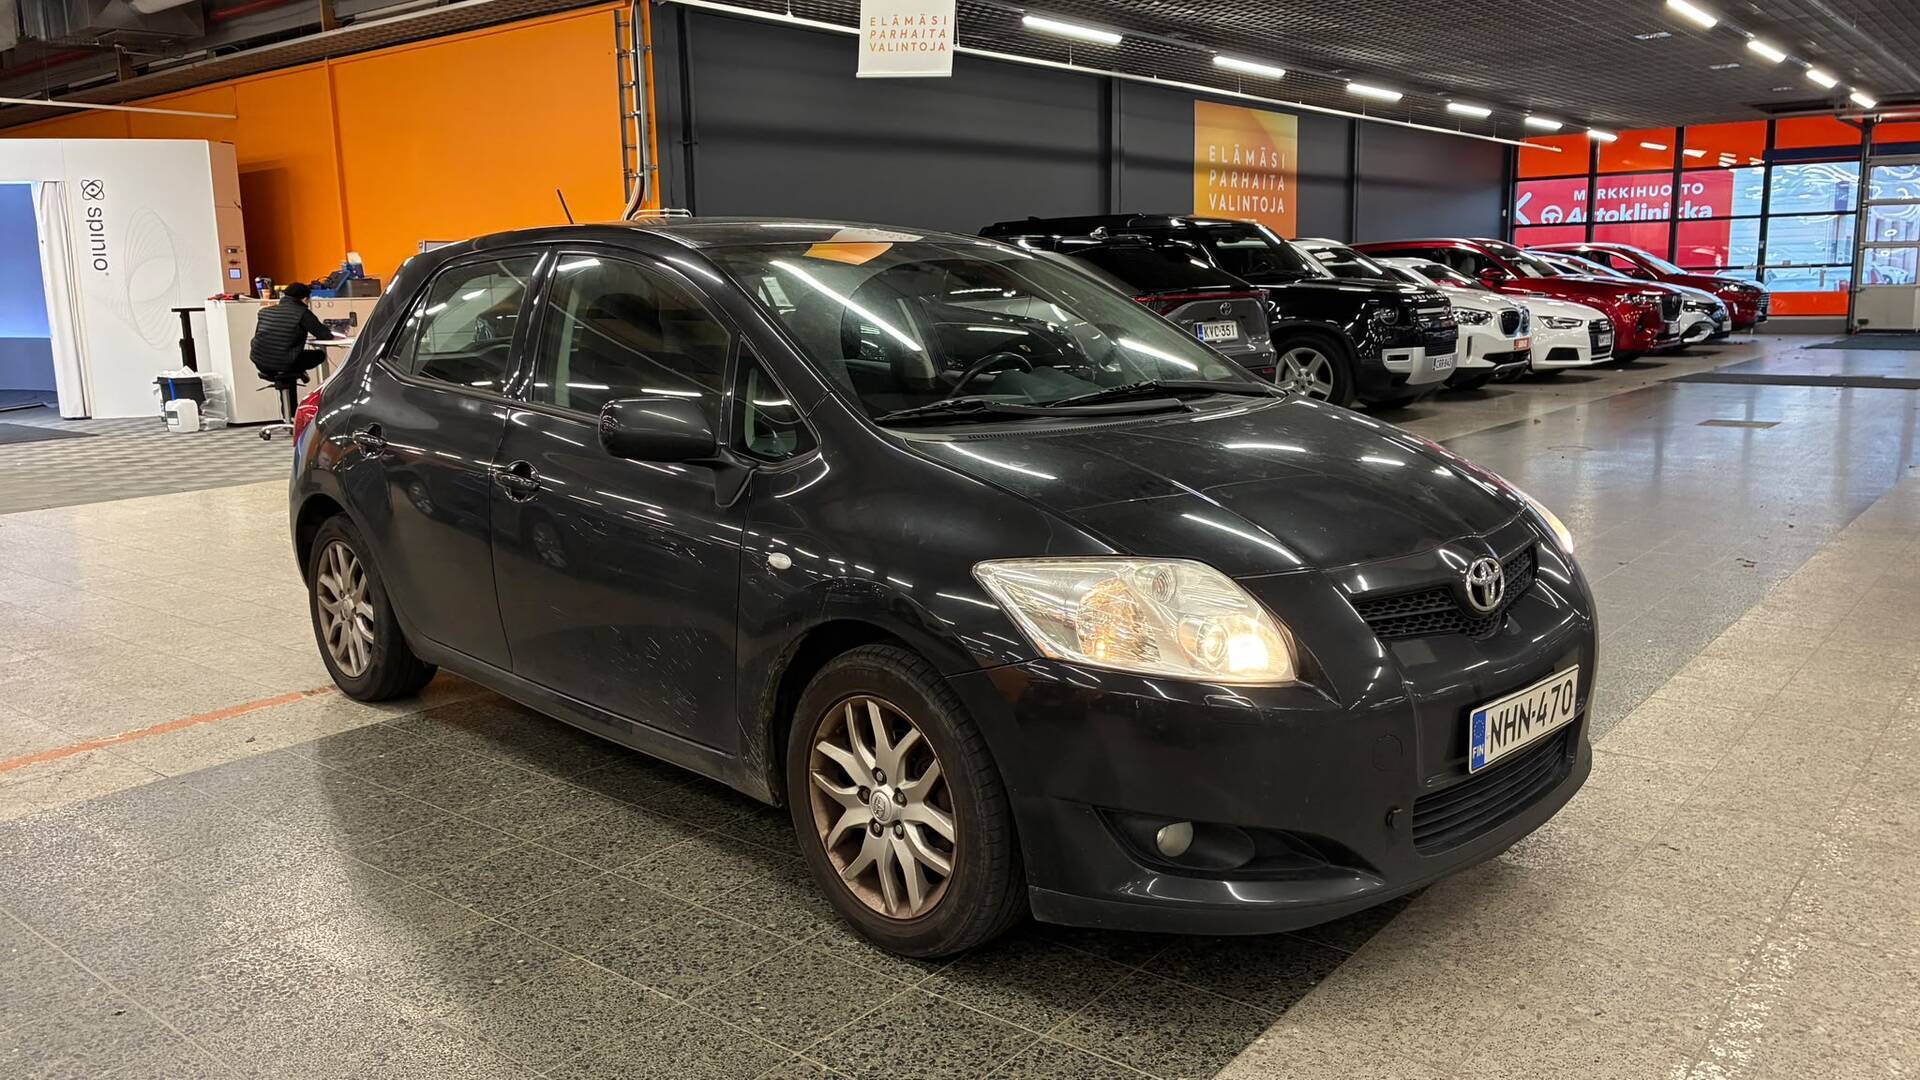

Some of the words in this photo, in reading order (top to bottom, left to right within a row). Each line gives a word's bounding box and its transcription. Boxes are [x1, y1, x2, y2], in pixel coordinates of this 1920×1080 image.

[870, 14, 947, 26] ELÄMÄSI
[870, 29, 946, 39] PARHAITA
[870, 42, 946, 52] VALINTOJA
[1209, 144, 1285, 169] ELÄMÄSI
[1209, 170, 1284, 191] PARHAITA
[1573, 182, 1704, 201] MRKKIHUOTO
[1209, 193, 1284, 213] VALINTOJA
[1490, 679, 1573, 754] NHN-470
